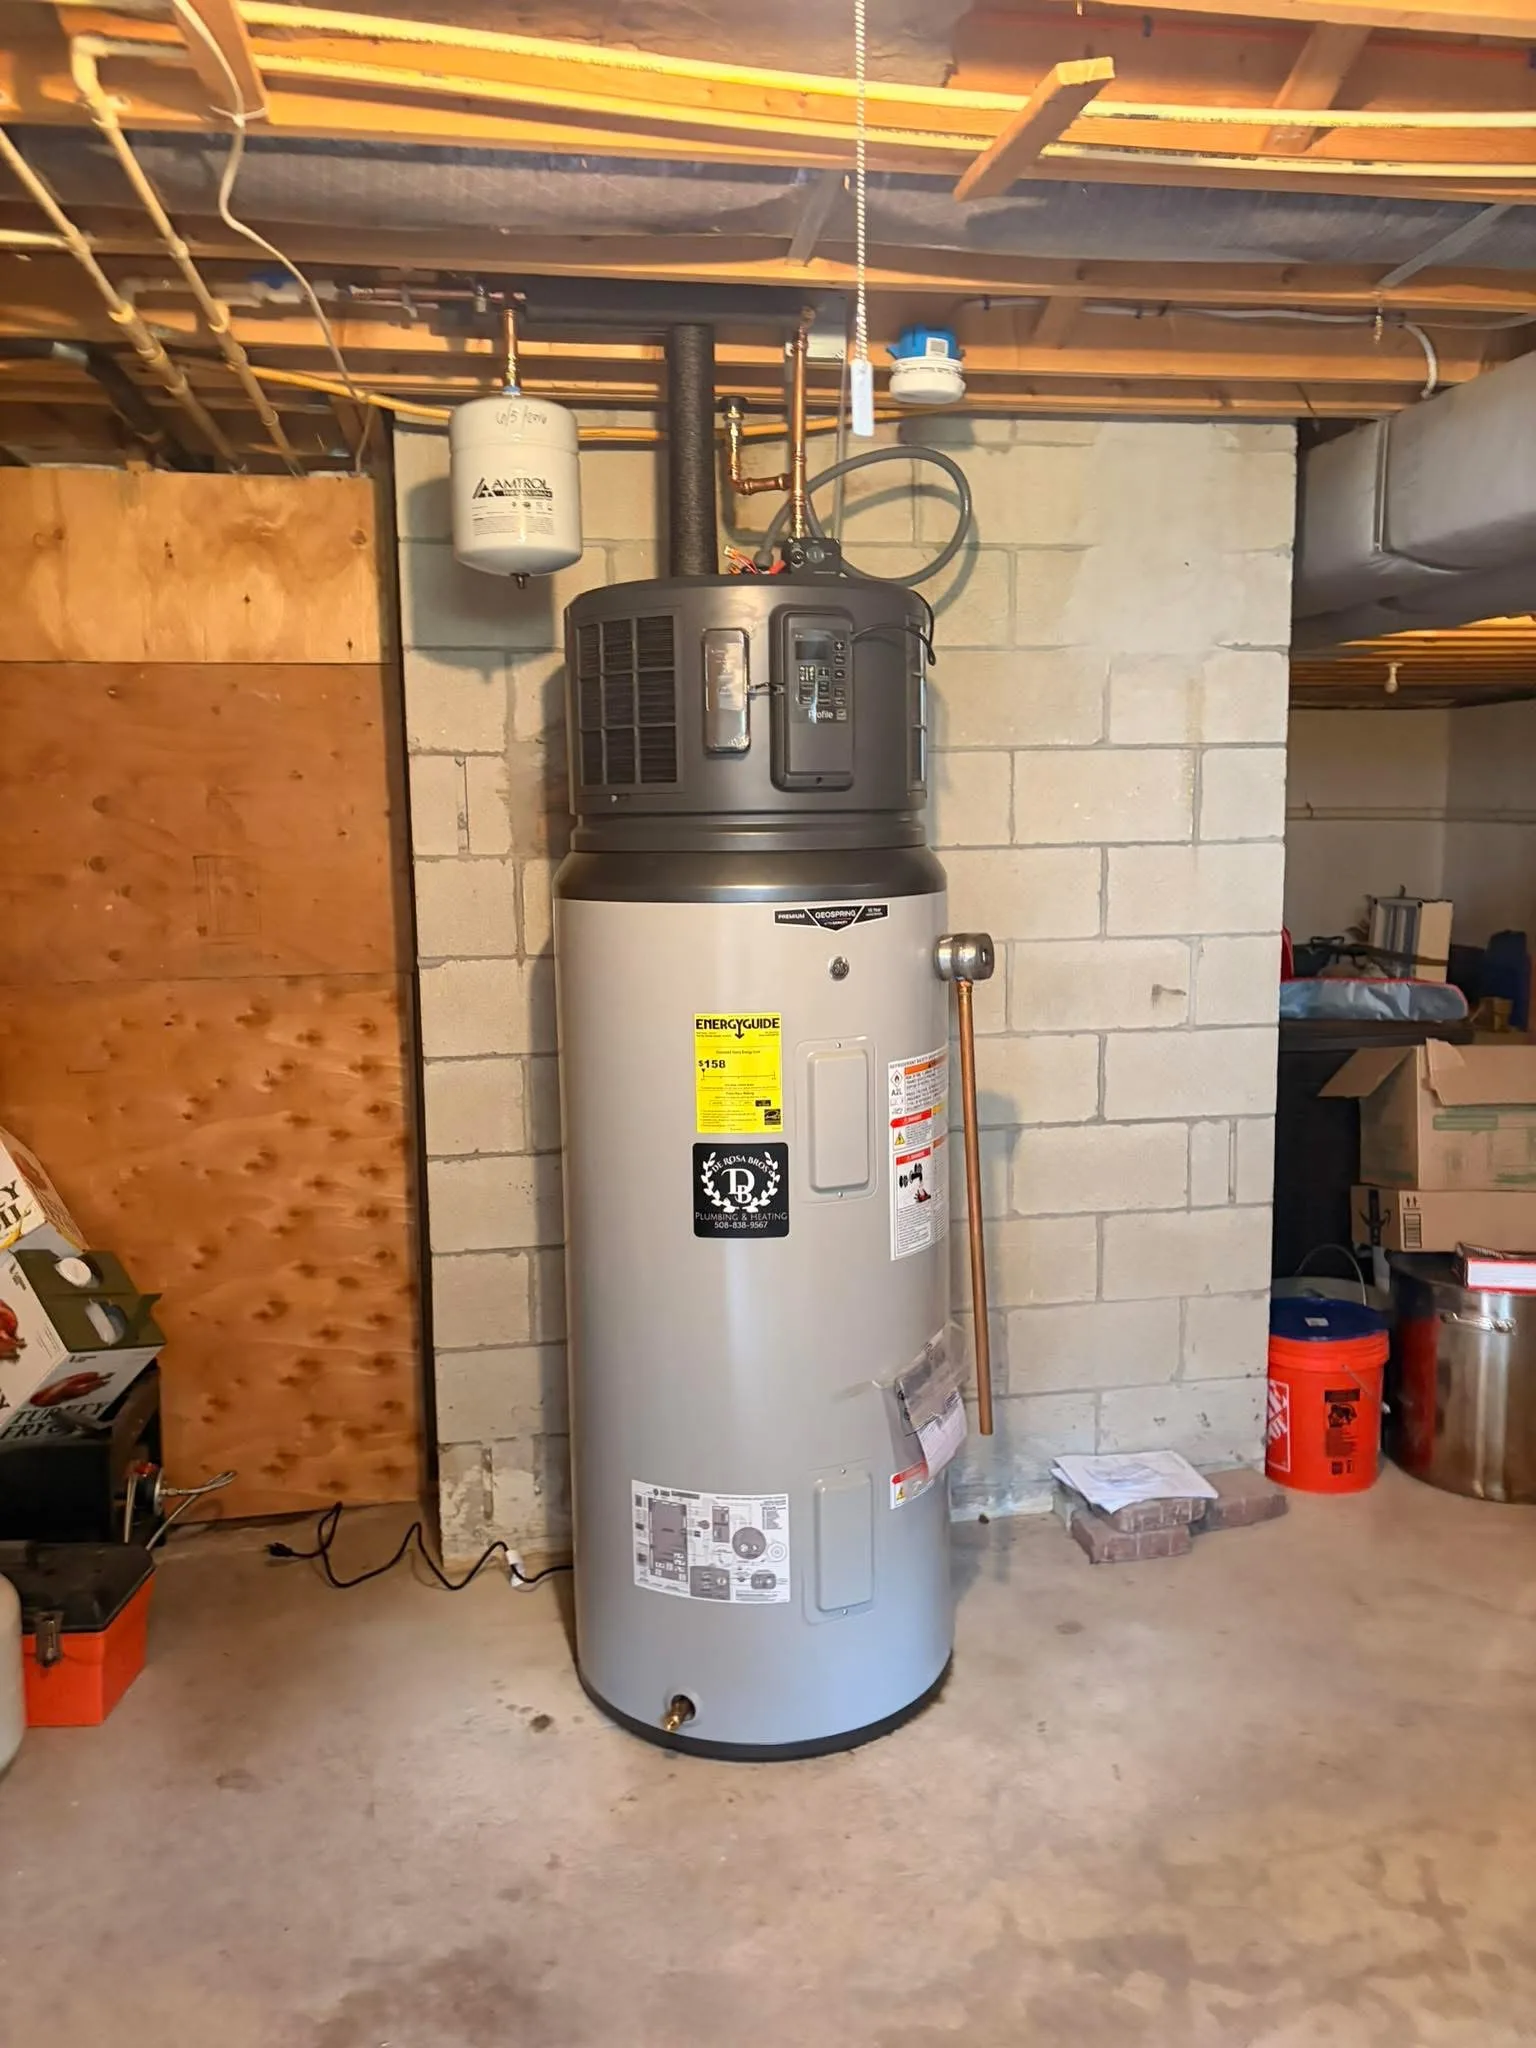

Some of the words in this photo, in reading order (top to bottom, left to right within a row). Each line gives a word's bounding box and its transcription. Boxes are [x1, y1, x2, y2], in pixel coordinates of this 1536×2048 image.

[492, 477, 552, 490] AMTROL
[808, 709, 834, 720] Pofile
[777, 912, 805, 920] PREMIUM
[815, 909, 856, 919] GEOSPRING
[696, 1018, 780, 1031] ENERGYGUIDE
[698, 1060, 726, 1069] $158
[711, 1162, 724, 1172] DE
[723, 1155, 747, 1165] ROSA
[748, 1156, 769, 1174] BROS
[695, 1212, 738, 1221] PLUMBING
[741, 1212, 747, 1220] &
[751, 1212, 788, 1221] HEATING
[714, 1221, 768, 1229] 508-838-9567
